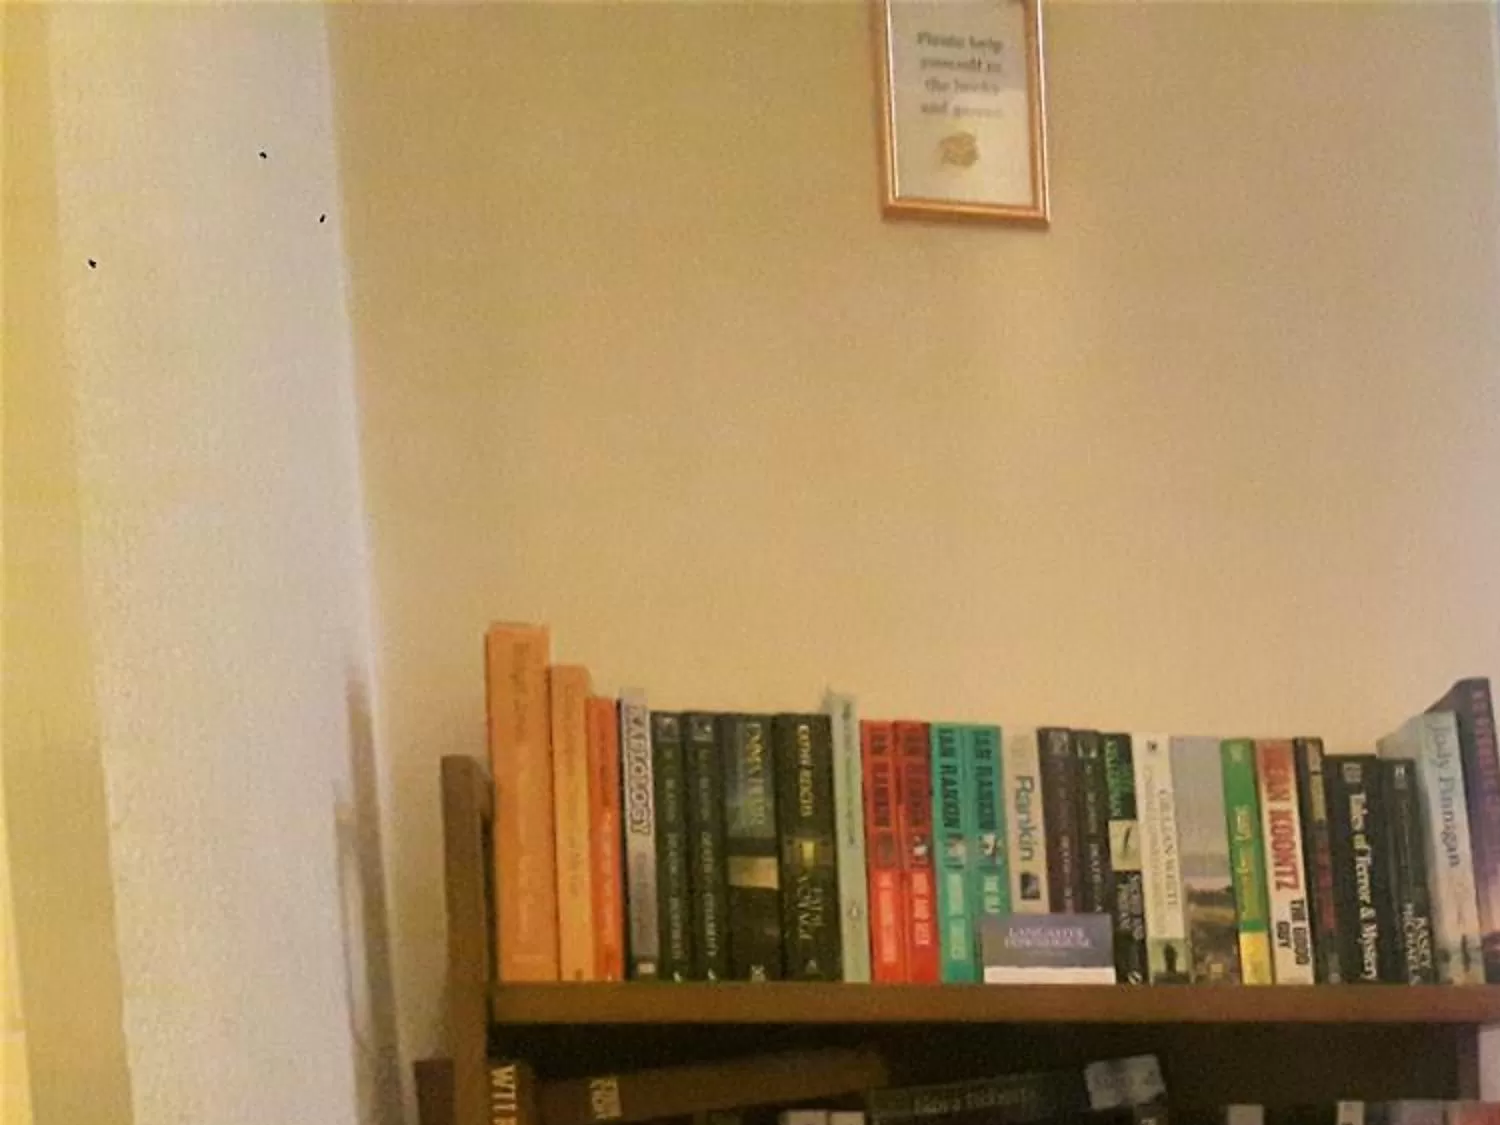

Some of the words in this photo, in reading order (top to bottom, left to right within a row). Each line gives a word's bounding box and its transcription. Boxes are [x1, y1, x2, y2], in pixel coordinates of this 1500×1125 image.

[1014, 774, 1036, 862] Rankin
[1268, 808, 1301, 893] KOONTZ
[1349, 793, 1367, 831] Tales
[1359, 922, 1379, 980] Mystery
